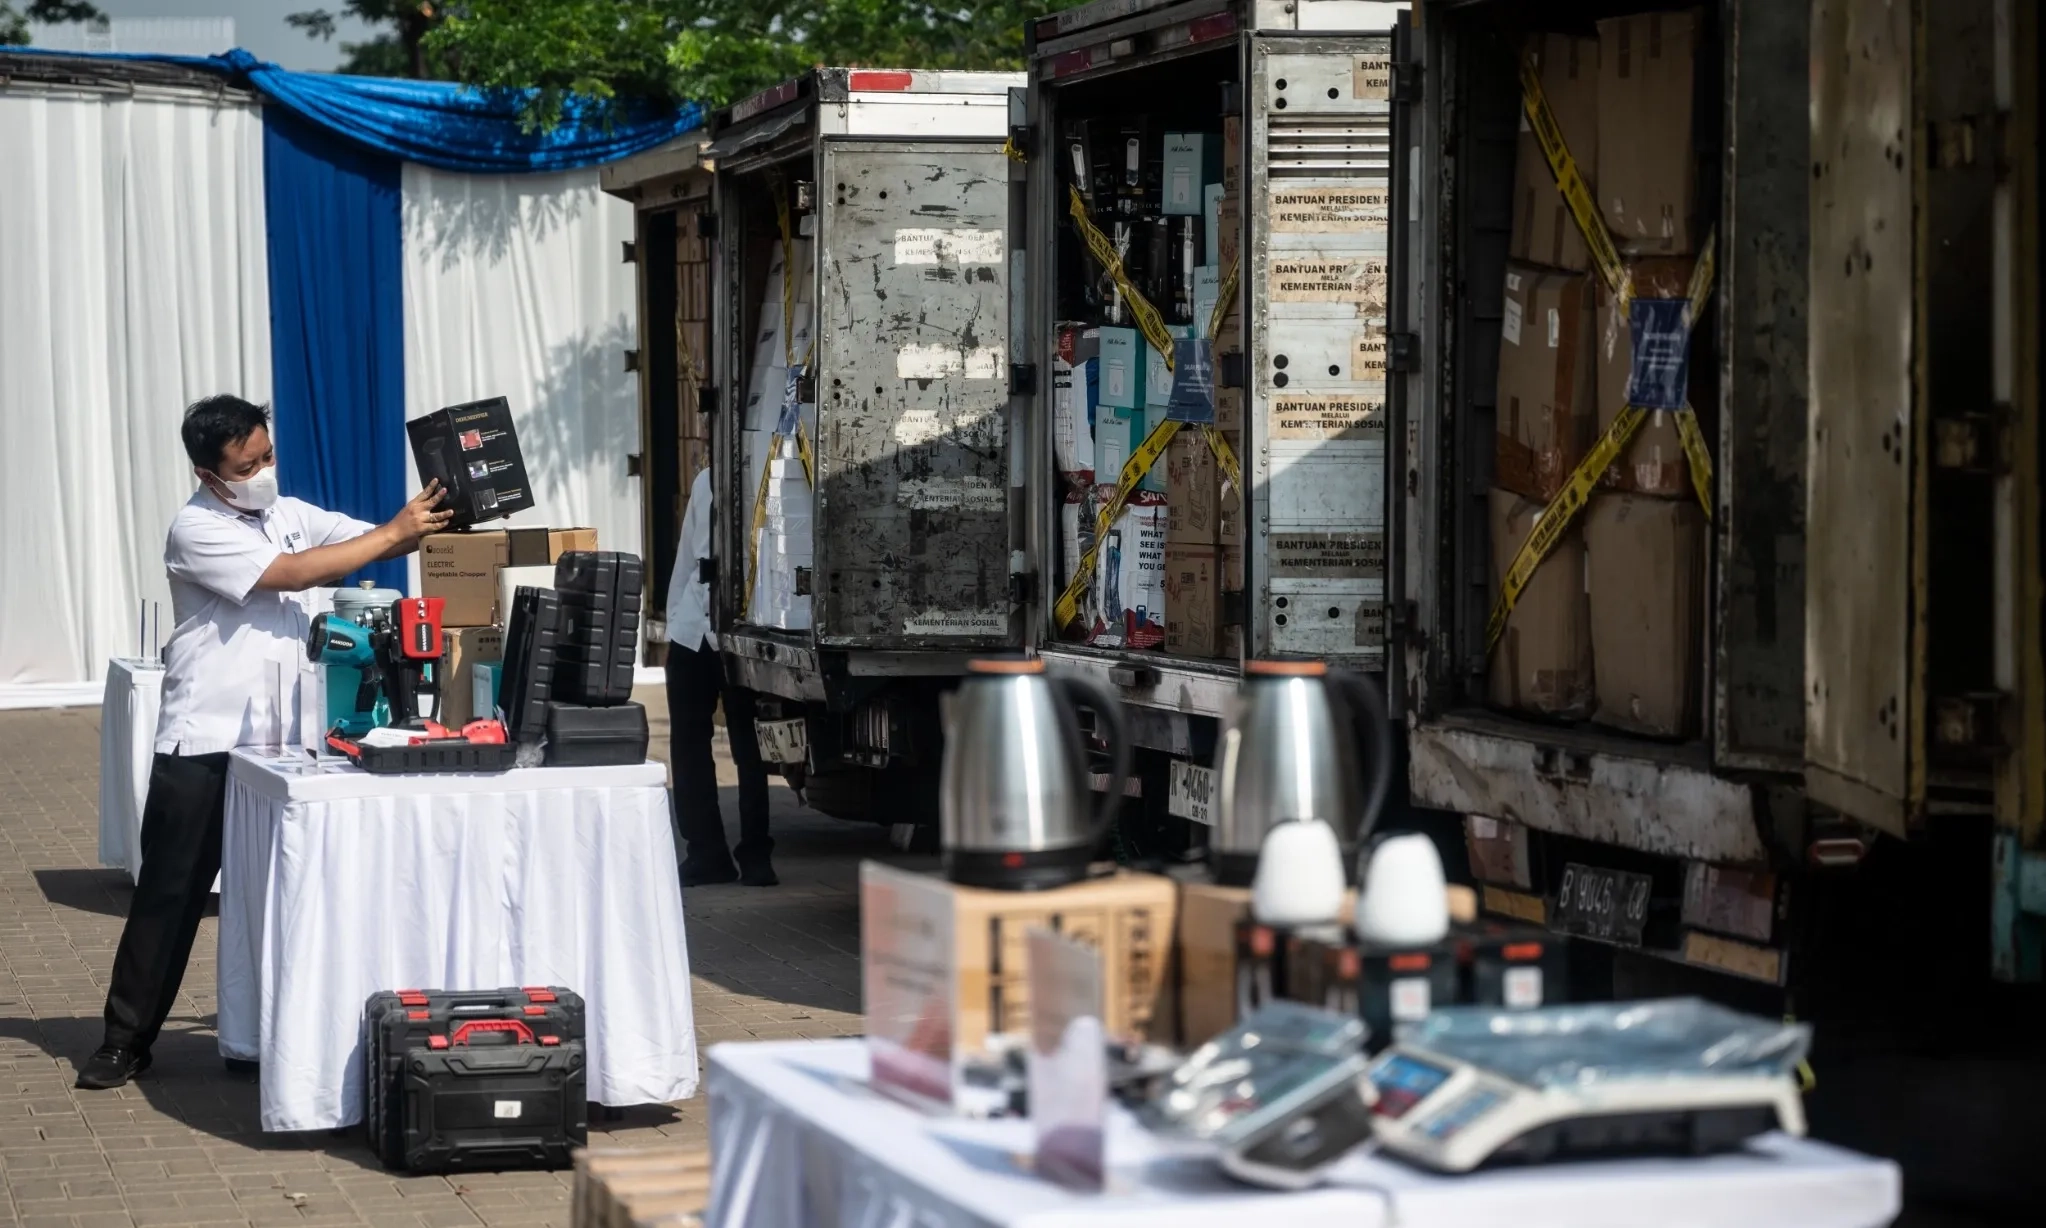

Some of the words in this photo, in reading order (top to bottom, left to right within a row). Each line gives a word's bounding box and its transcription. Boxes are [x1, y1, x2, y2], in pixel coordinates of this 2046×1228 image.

[1275, 195, 1326, 205] BANTUAN
[1328, 195, 1380, 205] PRESIDEN
[1275, 264, 1326, 274] BANTUAN
[1280, 282, 1352, 292] KEMENTERIAN
[1275, 402, 1326, 412] BANTUAN
[1329, 402, 1381, 412] PRESIDEN
[1140, 530, 1164, 539] WHAT
[1140, 541, 1156, 549] SEE
[1157, 541, 1165, 549] IS
[1276, 540, 1327, 550] BANTUAN
[1329, 540, 1382, 550] PRESIDEN
[1139, 552, 1162, 560] WHAT
[1138, 562, 1155, 571] YOU
[1281, 558, 1353, 568] KEMENTERIAN
[427, 571, 458, 579] Vegetable
[459, 571, 487, 579] Chopper
[912, 618, 970, 627] KEMENTERIAN
[971, 618, 999, 627] SOSIAL
[1559, 868, 1574, 909] B
